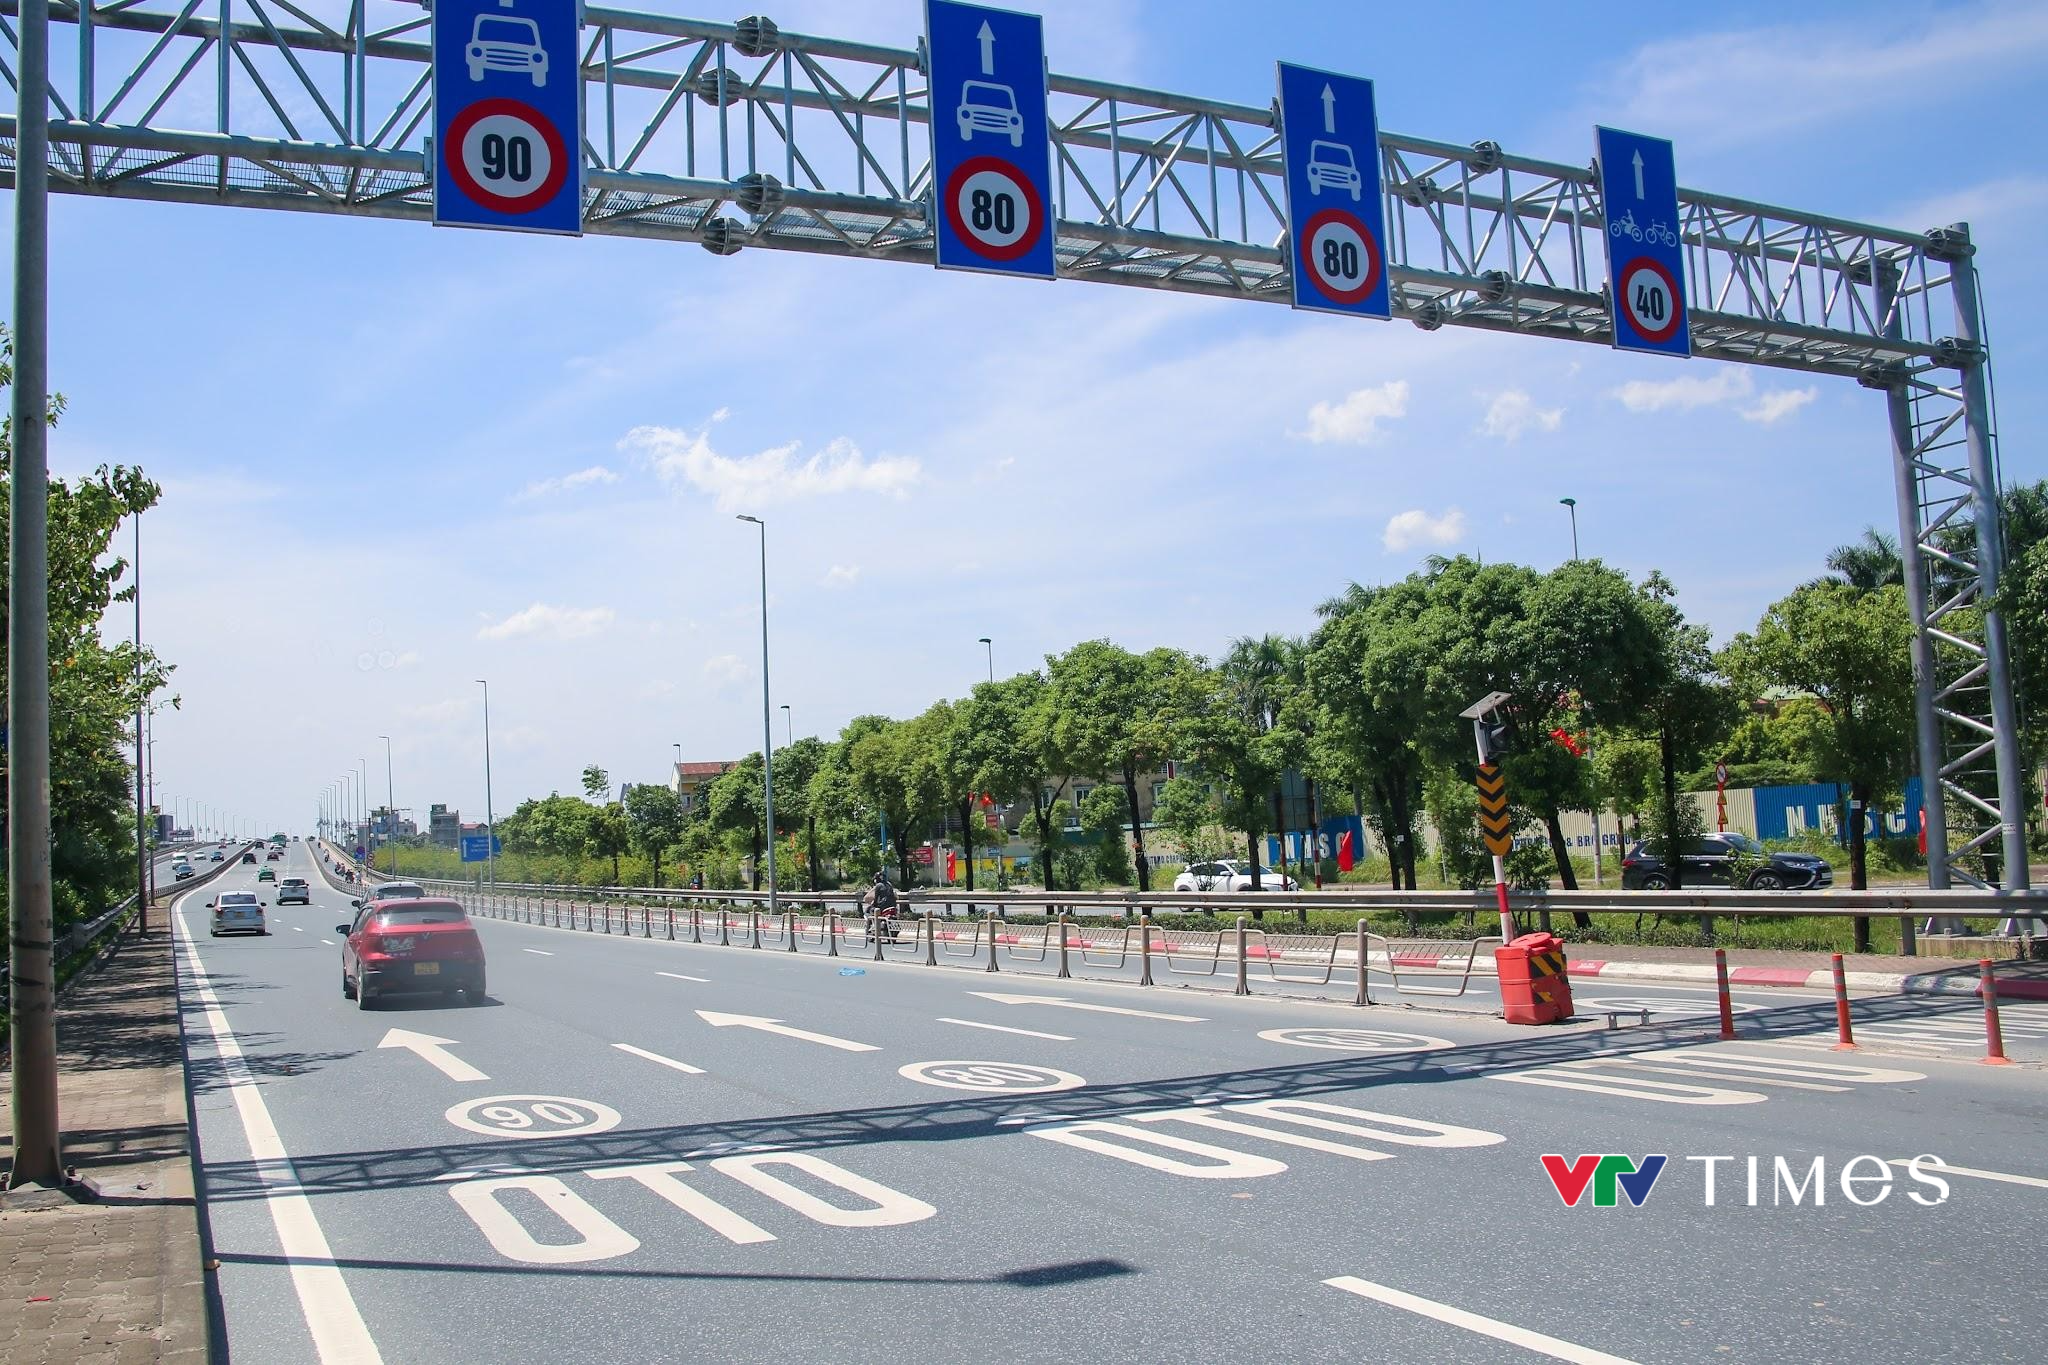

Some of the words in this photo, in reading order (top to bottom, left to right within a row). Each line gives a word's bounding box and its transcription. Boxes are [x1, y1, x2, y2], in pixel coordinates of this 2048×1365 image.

[481, 133, 532, 183] 90
[970, 189, 1016, 235] 80
[1322, 239, 1359, 280] 80
[1636, 284, 1664, 322] 40
[1295, 1031, 1414, 1047] 80
[934, 1065, 1044, 1087] 80
[480, 1101, 586, 1130] 90
